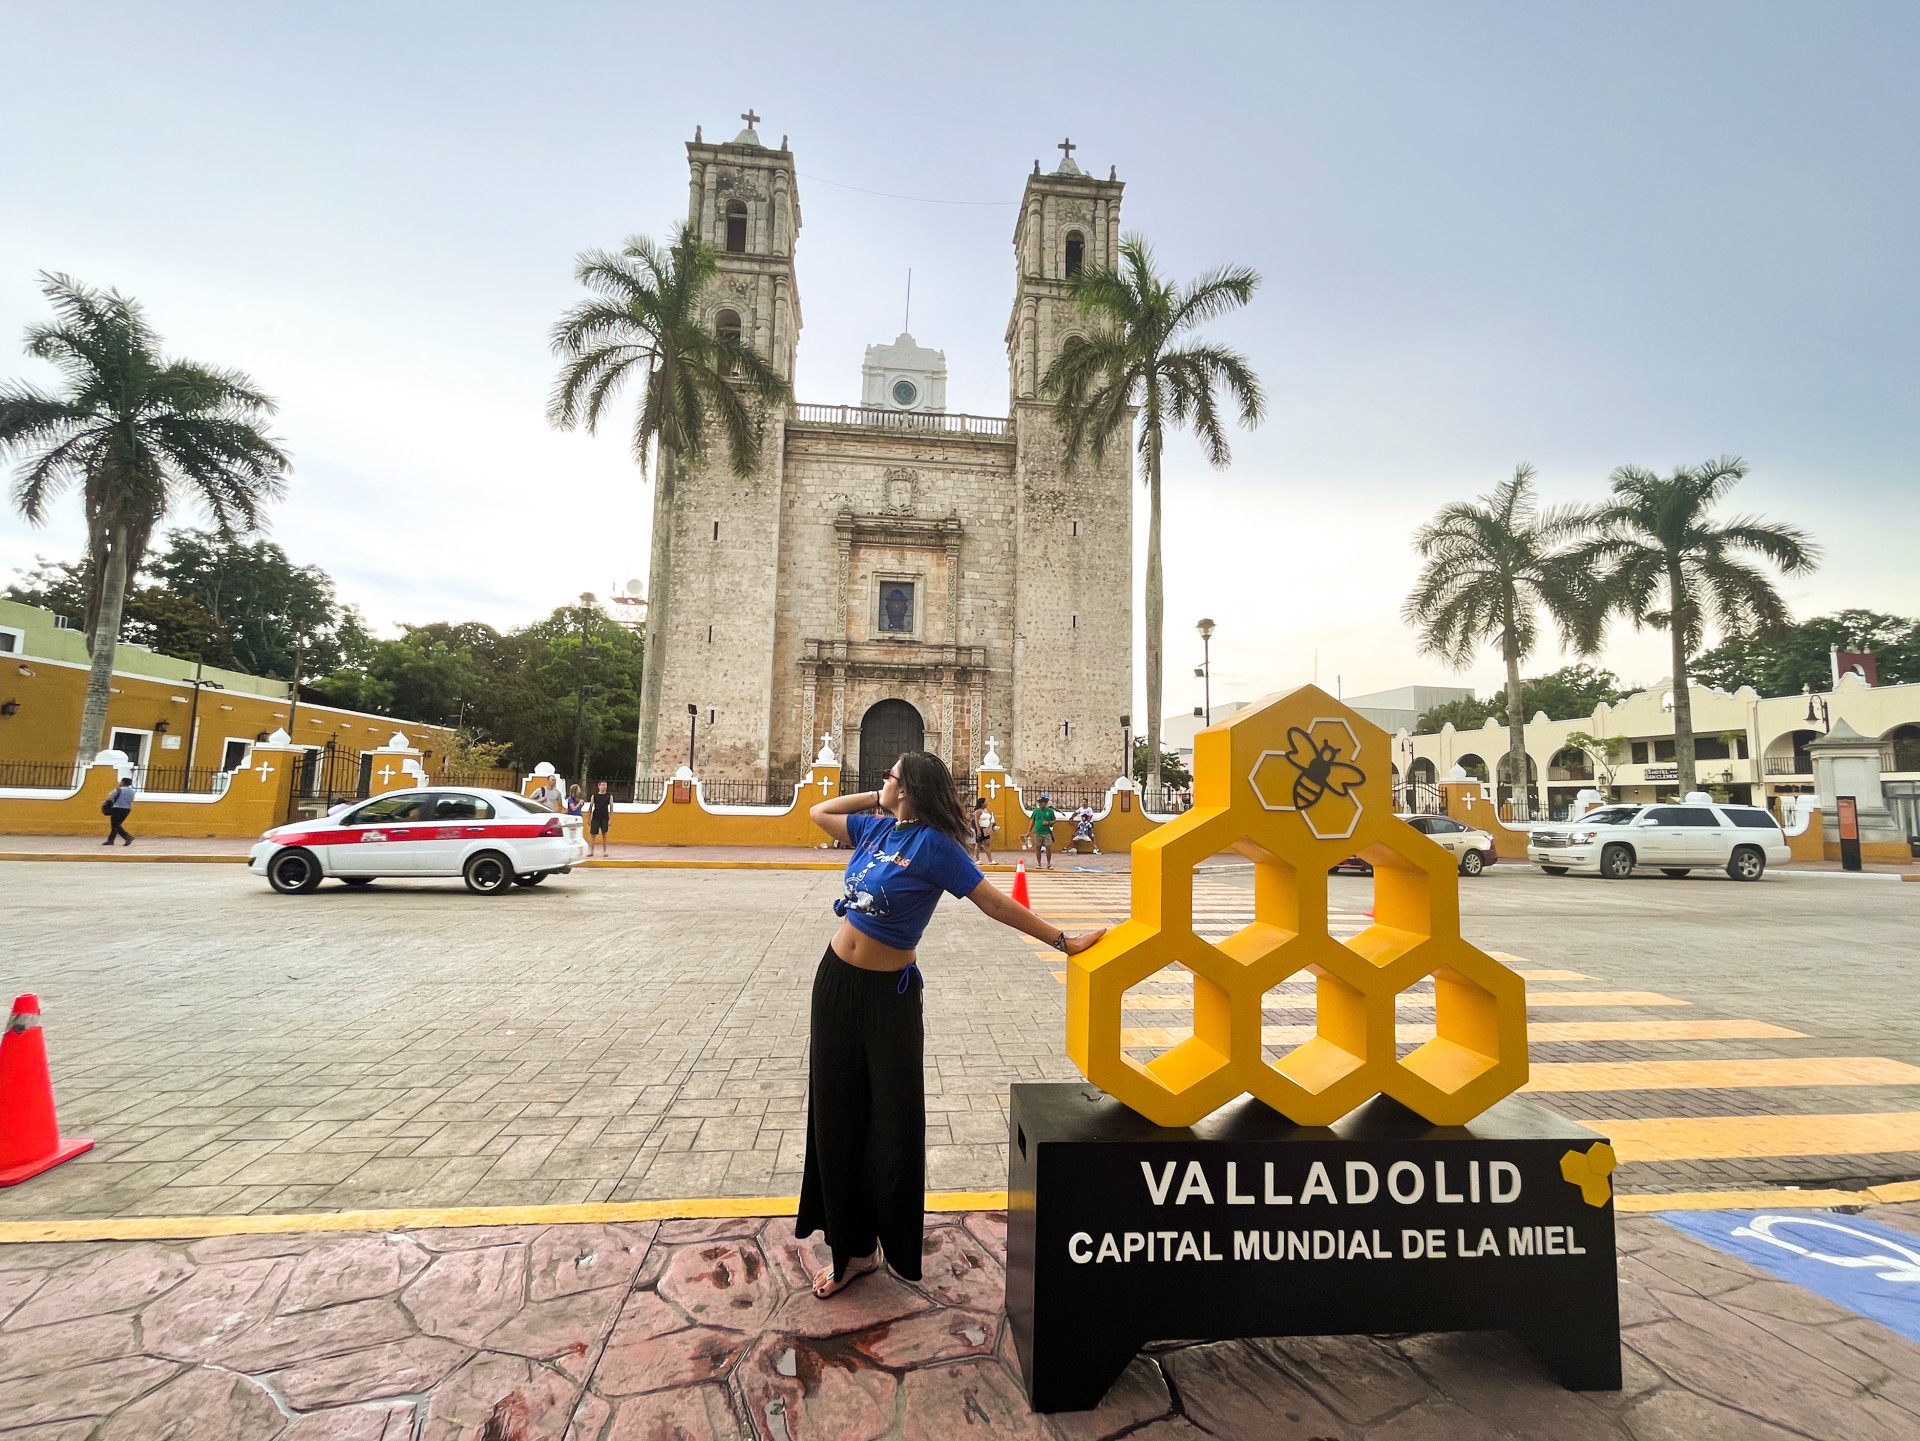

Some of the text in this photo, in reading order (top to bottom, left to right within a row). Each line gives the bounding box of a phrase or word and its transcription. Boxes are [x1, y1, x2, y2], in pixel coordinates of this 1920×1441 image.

[1140, 1160, 1523, 1205] VALLADOLID
[1068, 1226, 1586, 1264] CAPITAL MUNDIAL DE LA MIEL
